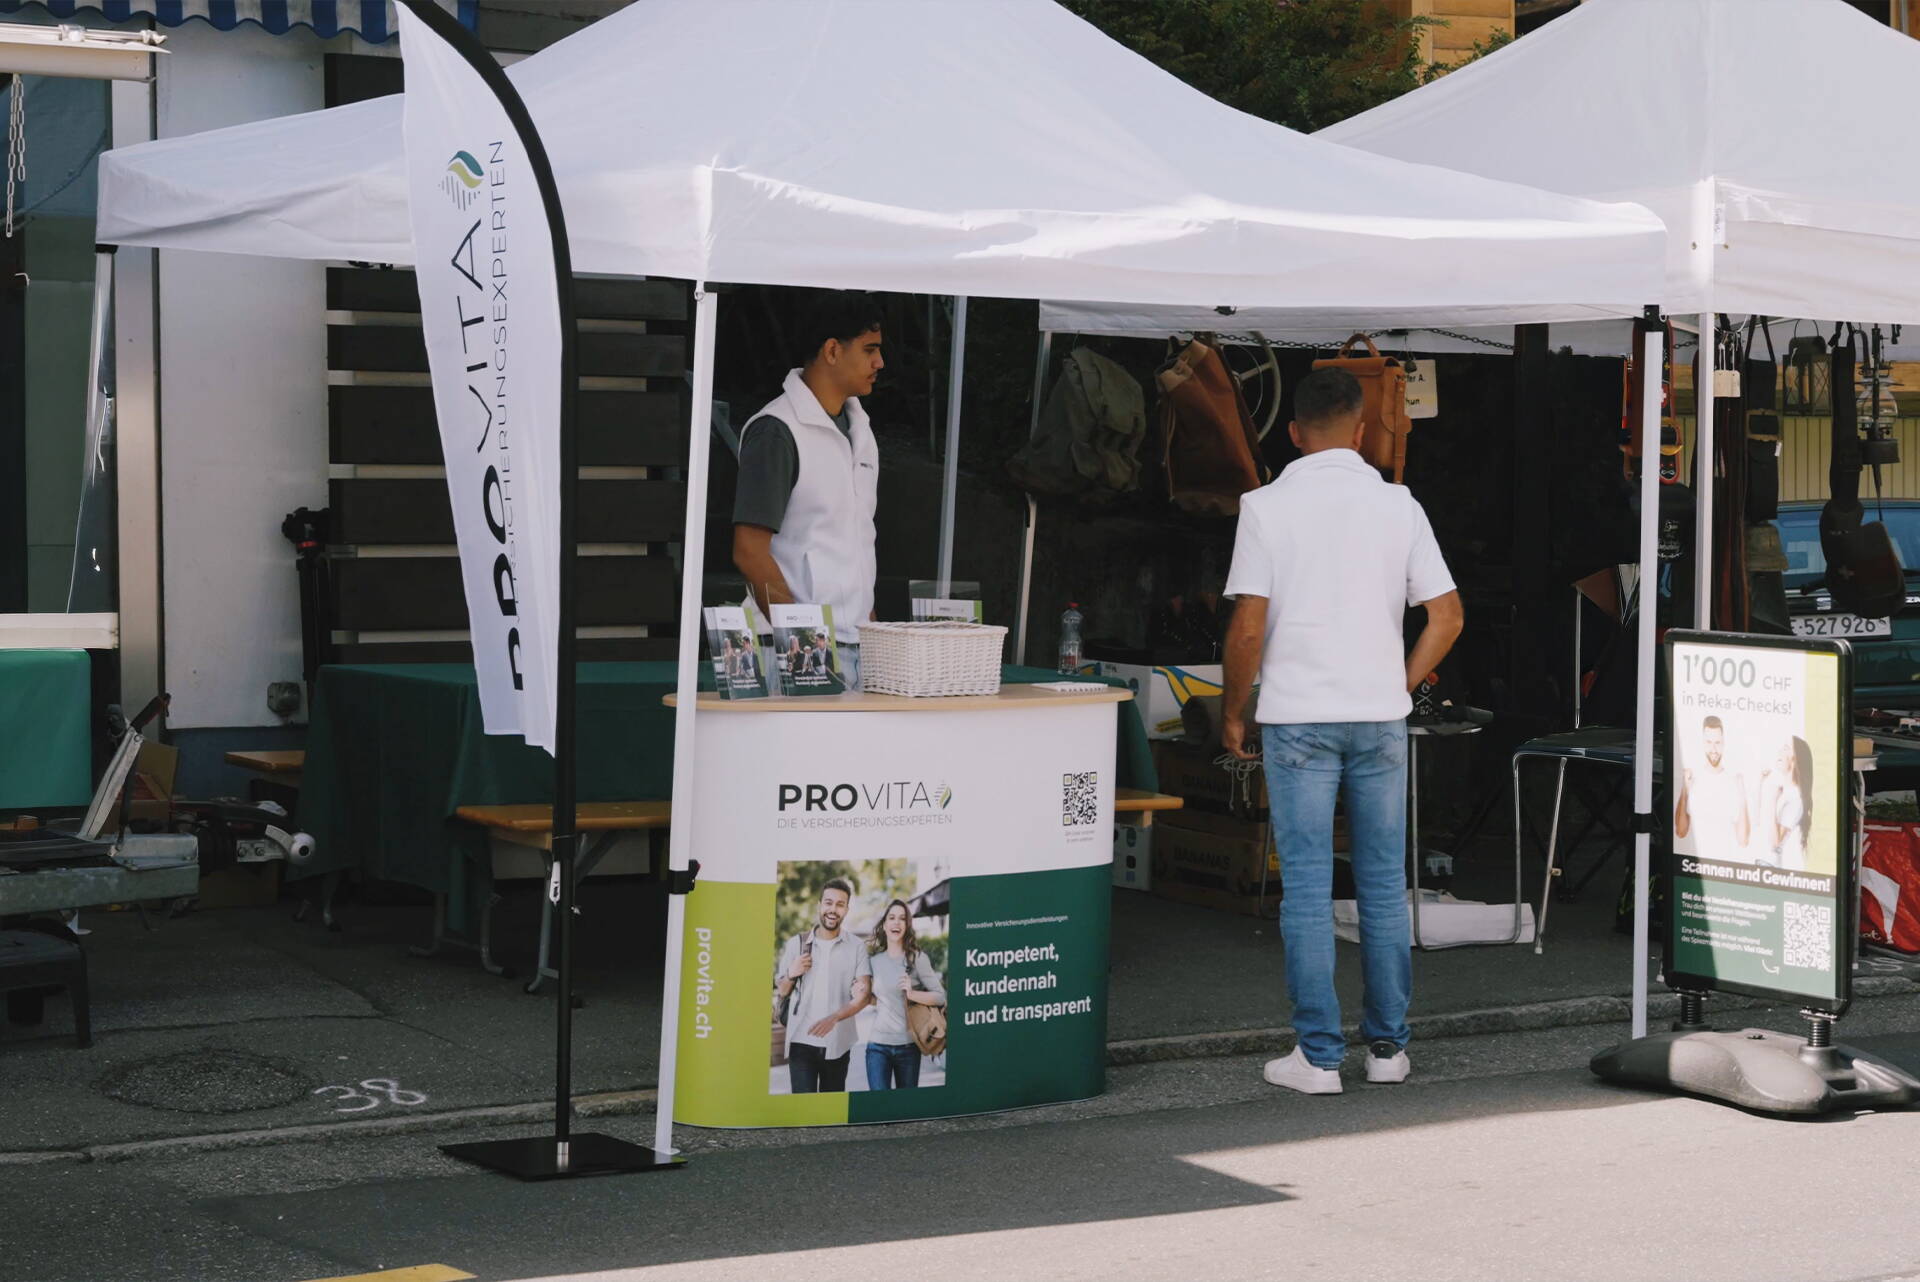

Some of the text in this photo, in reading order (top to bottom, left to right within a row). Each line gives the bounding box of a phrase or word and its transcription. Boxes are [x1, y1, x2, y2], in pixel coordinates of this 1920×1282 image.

[1762, 676, 1792, 690] CHF
[1682, 691, 1792, 714] in Reka-Checks!
[778, 781, 931, 812] PROVITA
[777, 814, 952, 829] DIE VERSICHERUNGSEXPERTEN
[1682, 859, 1831, 892] Scannen und Gewinnen!
[966, 943, 1060, 968] Kompetent,
[695, 927, 715, 1039] provita.ch
[965, 971, 1057, 996] kundennah
[964, 995, 1092, 1025] und transparent
[313, 1078, 427, 1112] 38
